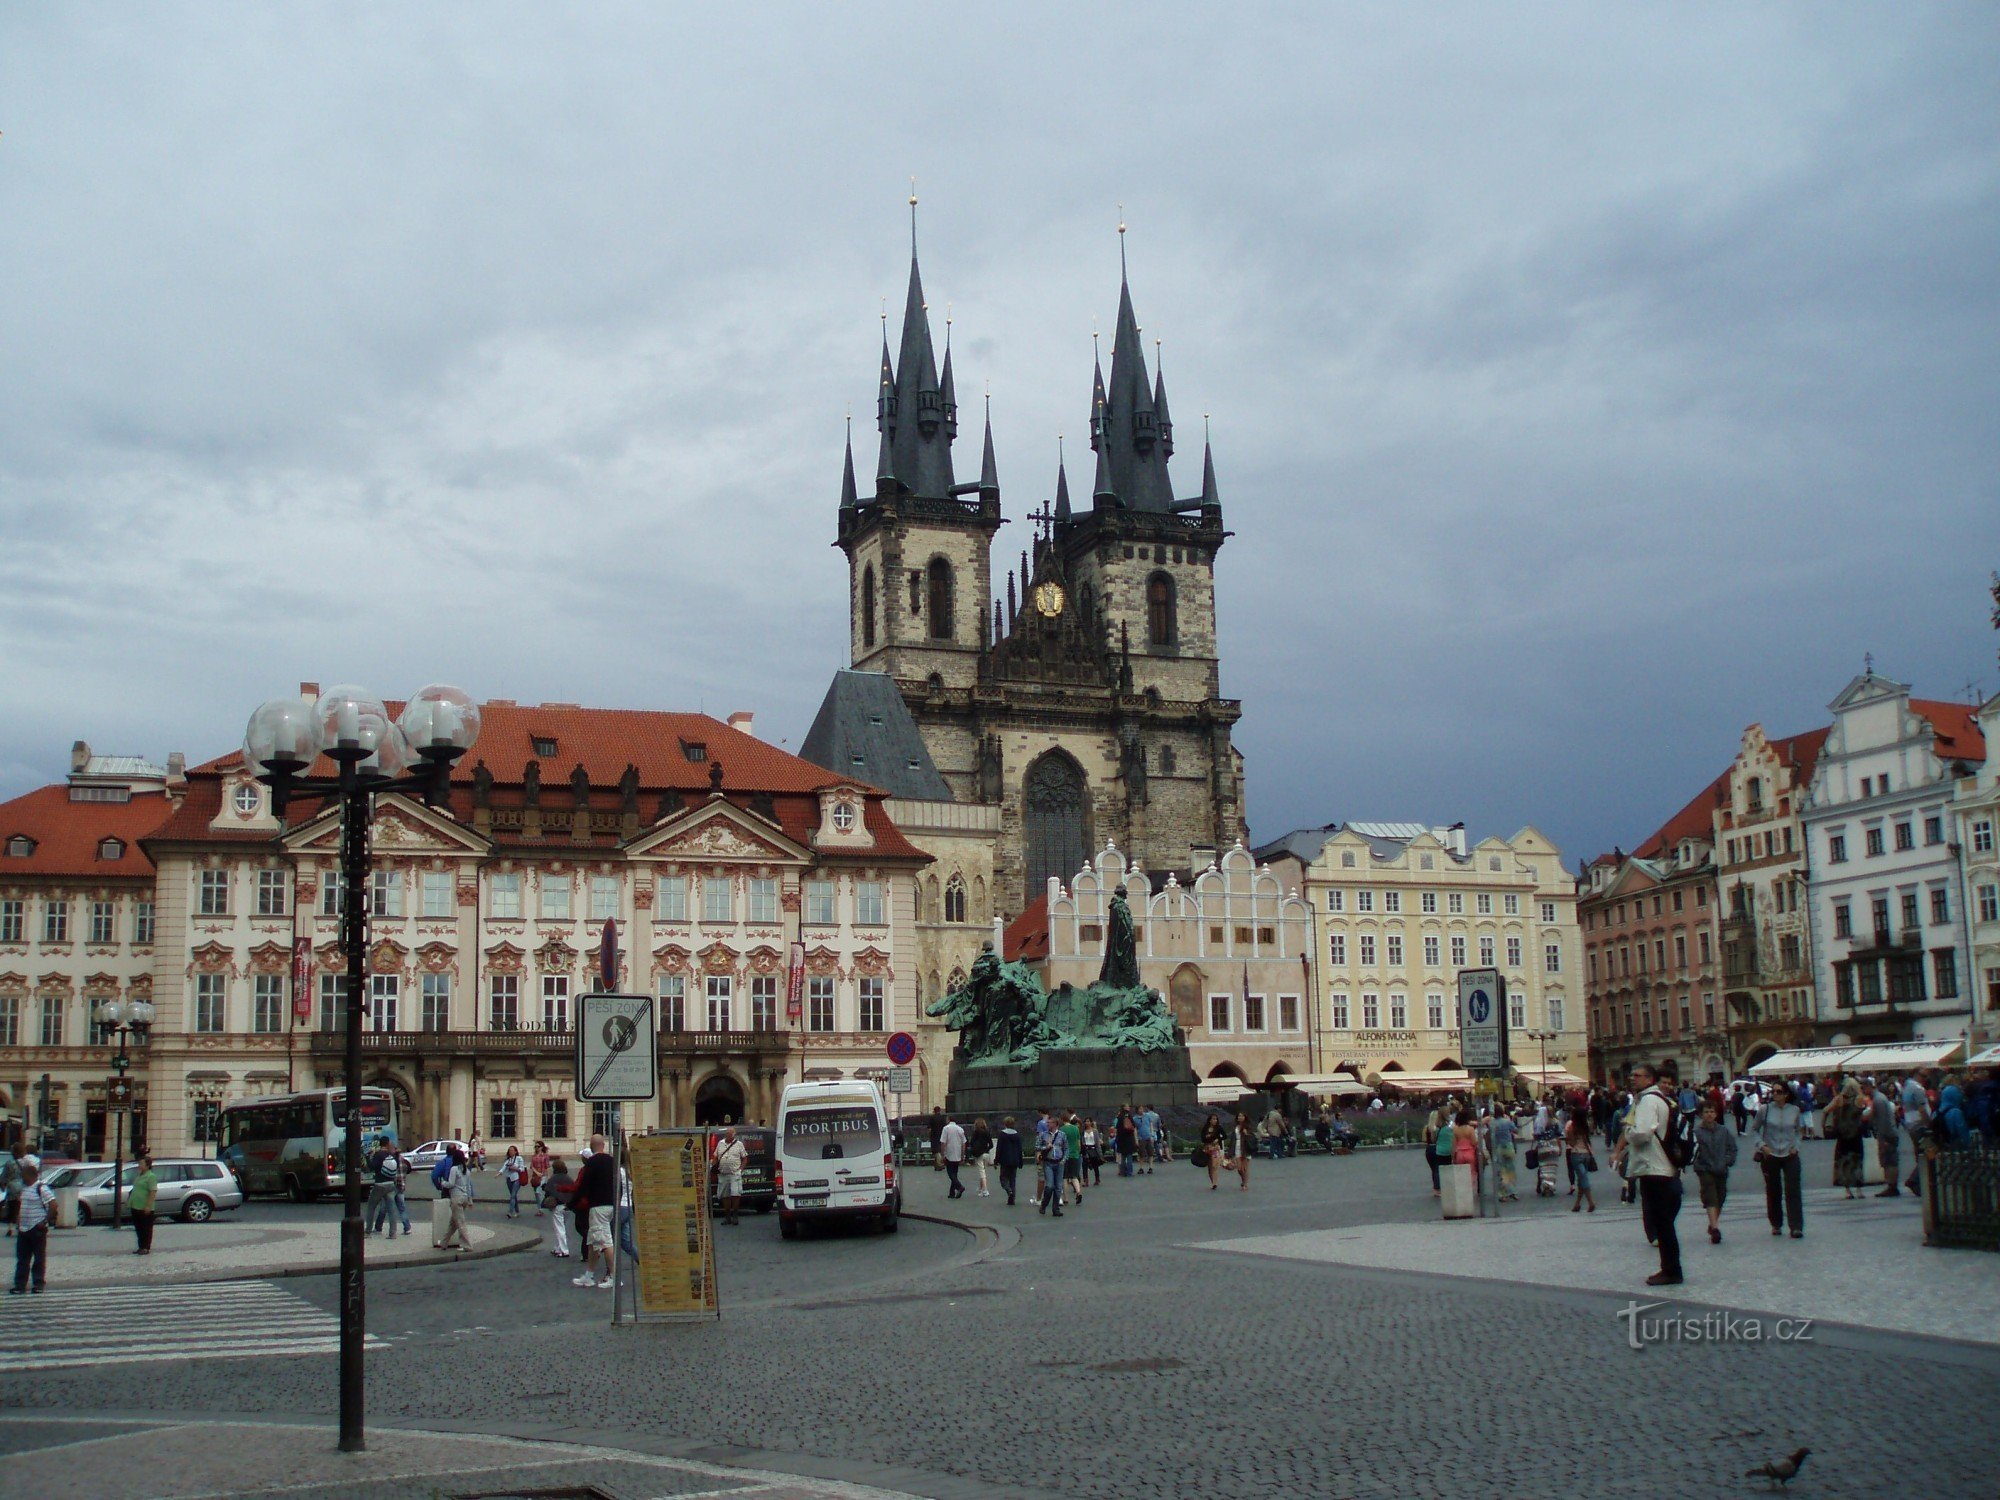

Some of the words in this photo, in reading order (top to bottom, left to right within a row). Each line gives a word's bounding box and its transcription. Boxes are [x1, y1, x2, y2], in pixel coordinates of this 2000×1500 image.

[617, 1000, 645, 1014] ZÓN
[1356, 1032, 1386, 1041] ALFONS
[1387, 1032, 1417, 1041] MUCHA
[792, 1119, 869, 1136] SPORTBUS
